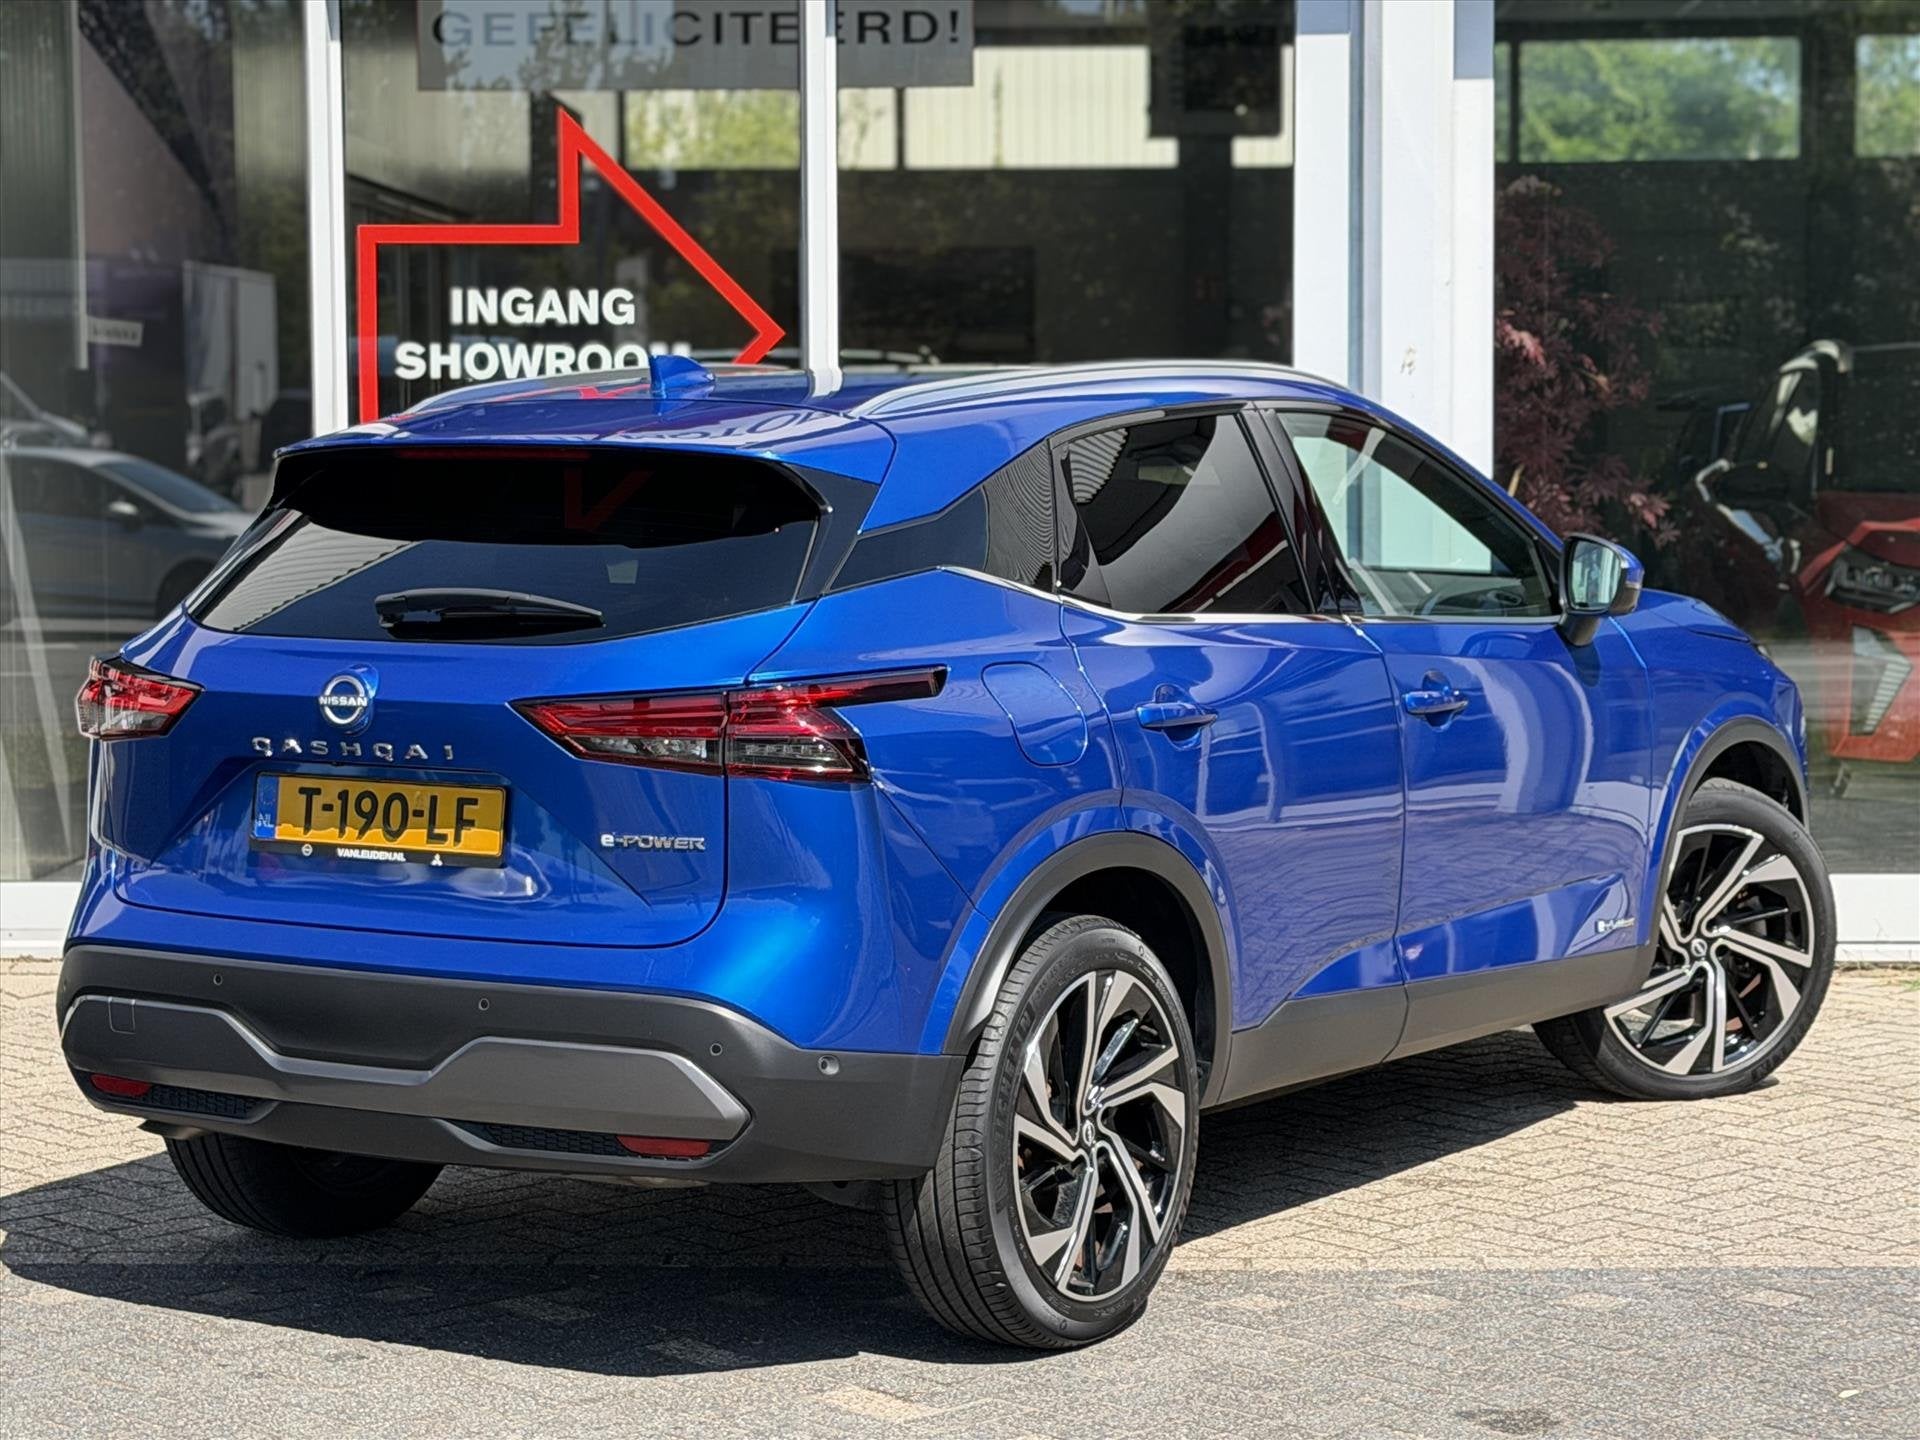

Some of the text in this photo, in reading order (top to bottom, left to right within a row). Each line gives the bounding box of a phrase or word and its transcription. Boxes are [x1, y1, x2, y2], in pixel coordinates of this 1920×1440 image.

[432, 10, 959, 47] GEFELICITERD!
[450, 287, 637, 325] INGANG
[318, 695, 368, 707] NISSAN
[252, 736, 454, 762] QASHQAI
[298, 786, 479, 848] T-190-LF
